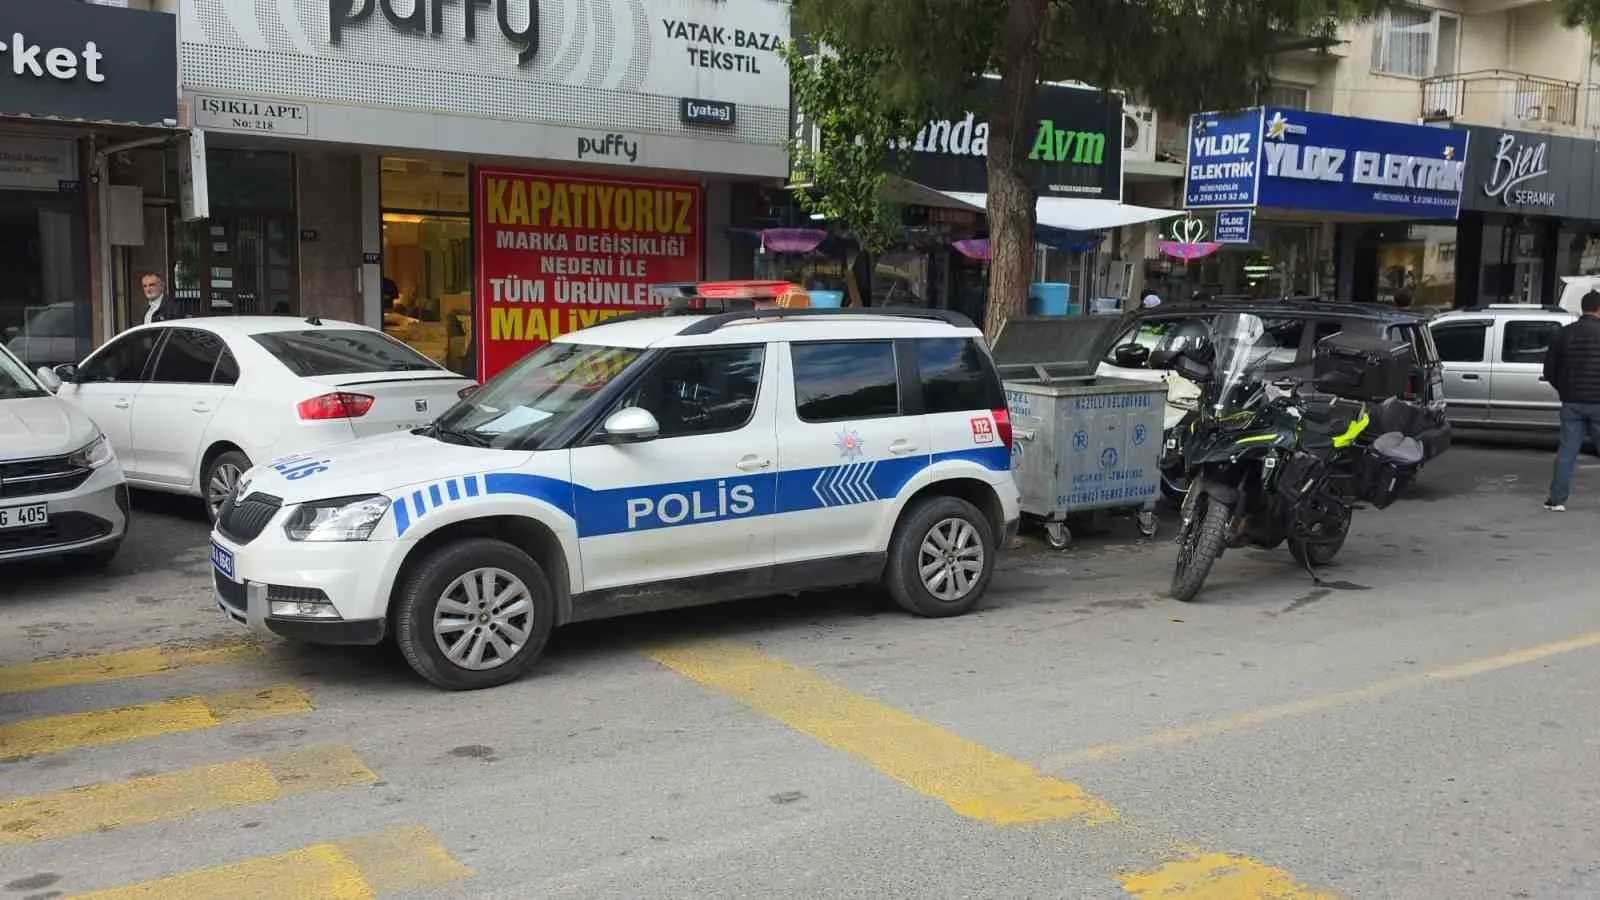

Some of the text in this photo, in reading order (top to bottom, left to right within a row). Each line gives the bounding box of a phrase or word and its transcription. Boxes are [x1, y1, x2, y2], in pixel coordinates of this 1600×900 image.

[0, 32, 105, 83] ket
[232, 118, 252, 128] No:
[264, 105, 303, 119] APT.
[578, 134, 637, 162] puffy
[1028, 119, 1105, 164] Avm
[1194, 133, 1251, 157] YILDIZ
[1191, 158, 1254, 180] ELEKTRİK
[1264, 142, 1345, 182] YILDIZ
[1485, 133, 1549, 204] Bien
[487, 178, 693, 234] KAPATIYORUZ
[496, 231, 685, 257] MARKA DEĞİŞİKLİĞİ
[541, 257, 647, 277] NEDENİ İLE
[490, 275, 674, 305] TÜM ÜRÜNLER
[973, 419, 990, 433] 112
[18, 507, 45, 523] 405
[626, 479, 755, 529] POLİS
